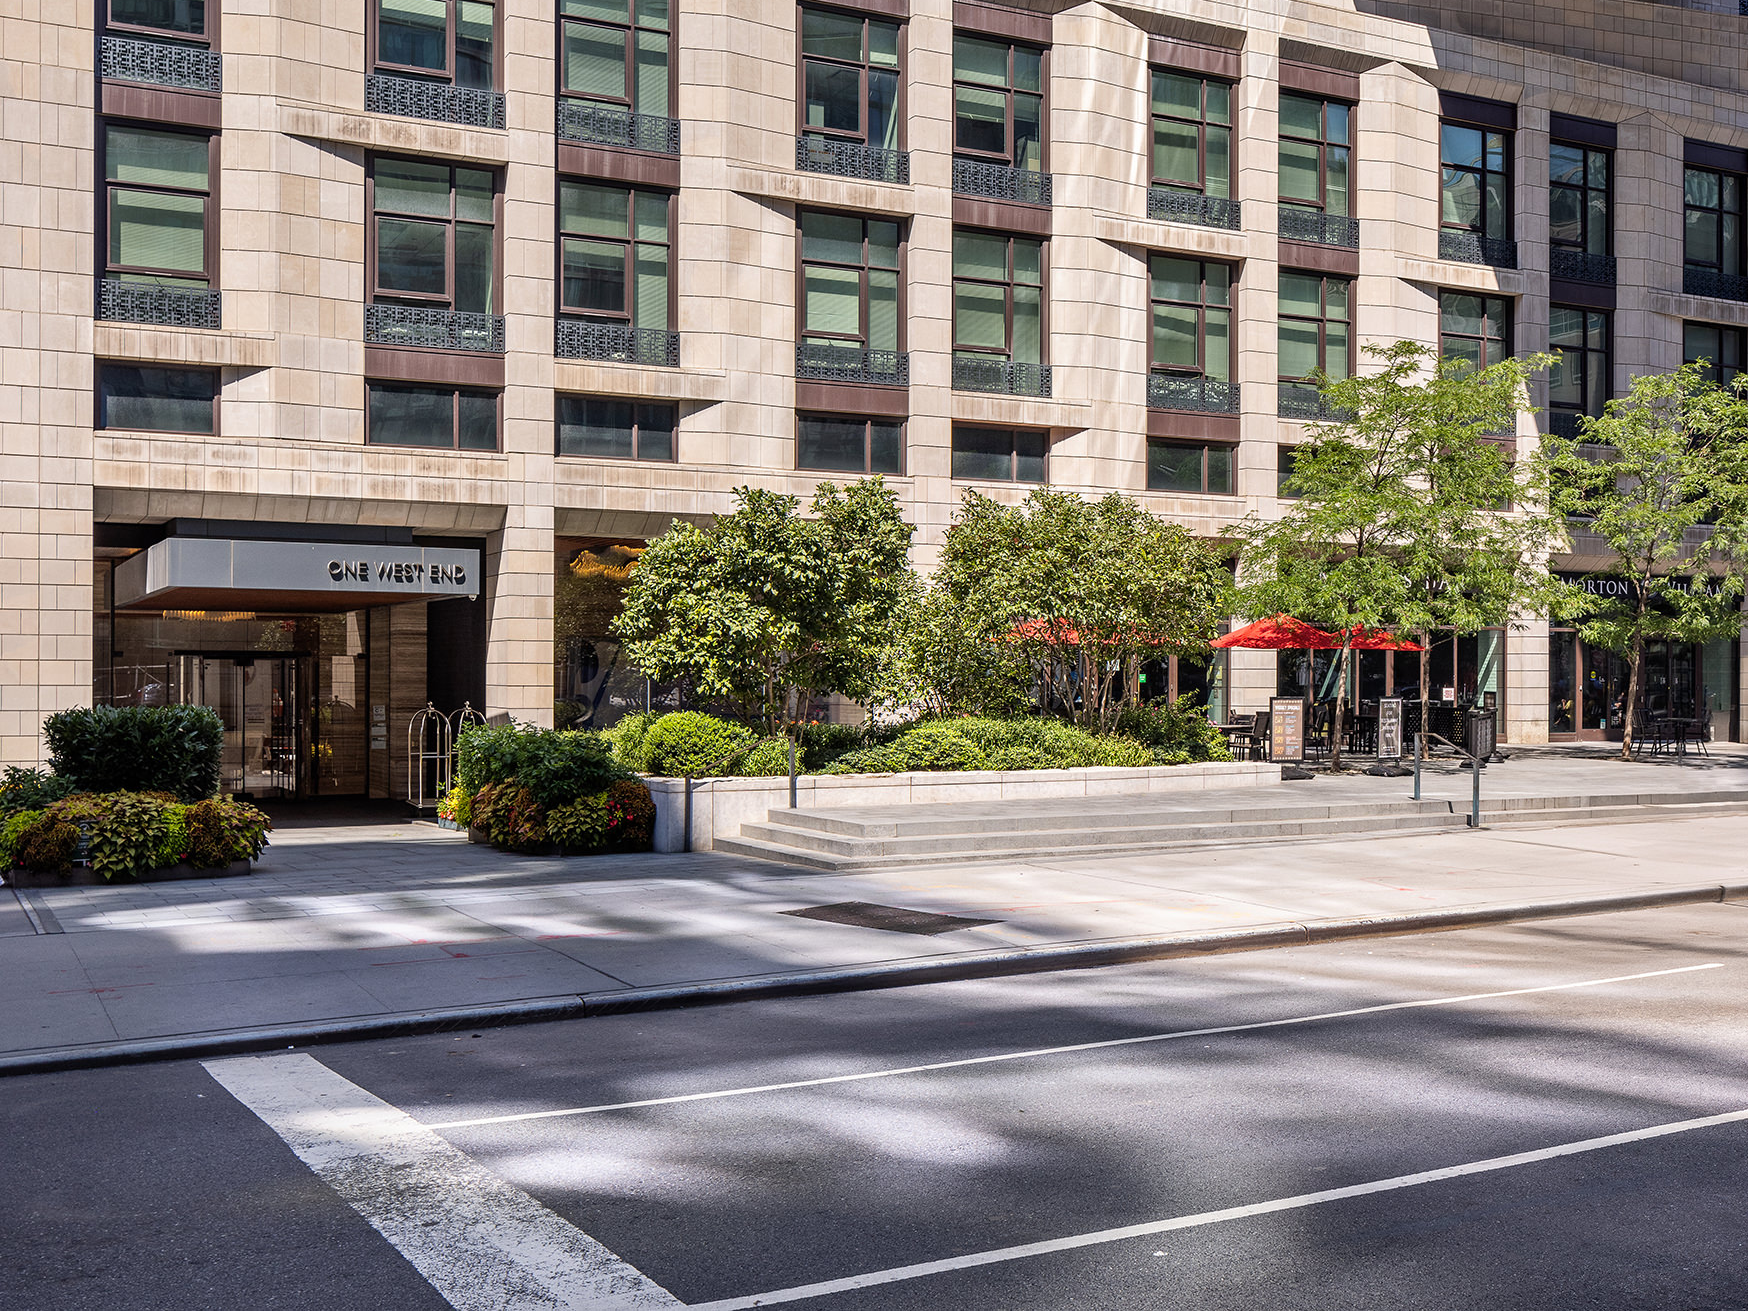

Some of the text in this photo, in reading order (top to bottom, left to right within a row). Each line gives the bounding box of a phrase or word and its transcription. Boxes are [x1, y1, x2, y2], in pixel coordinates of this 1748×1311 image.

[327, 560, 465, 579] ONE WEST END
[1560, 576, 1628, 595] MORTON
